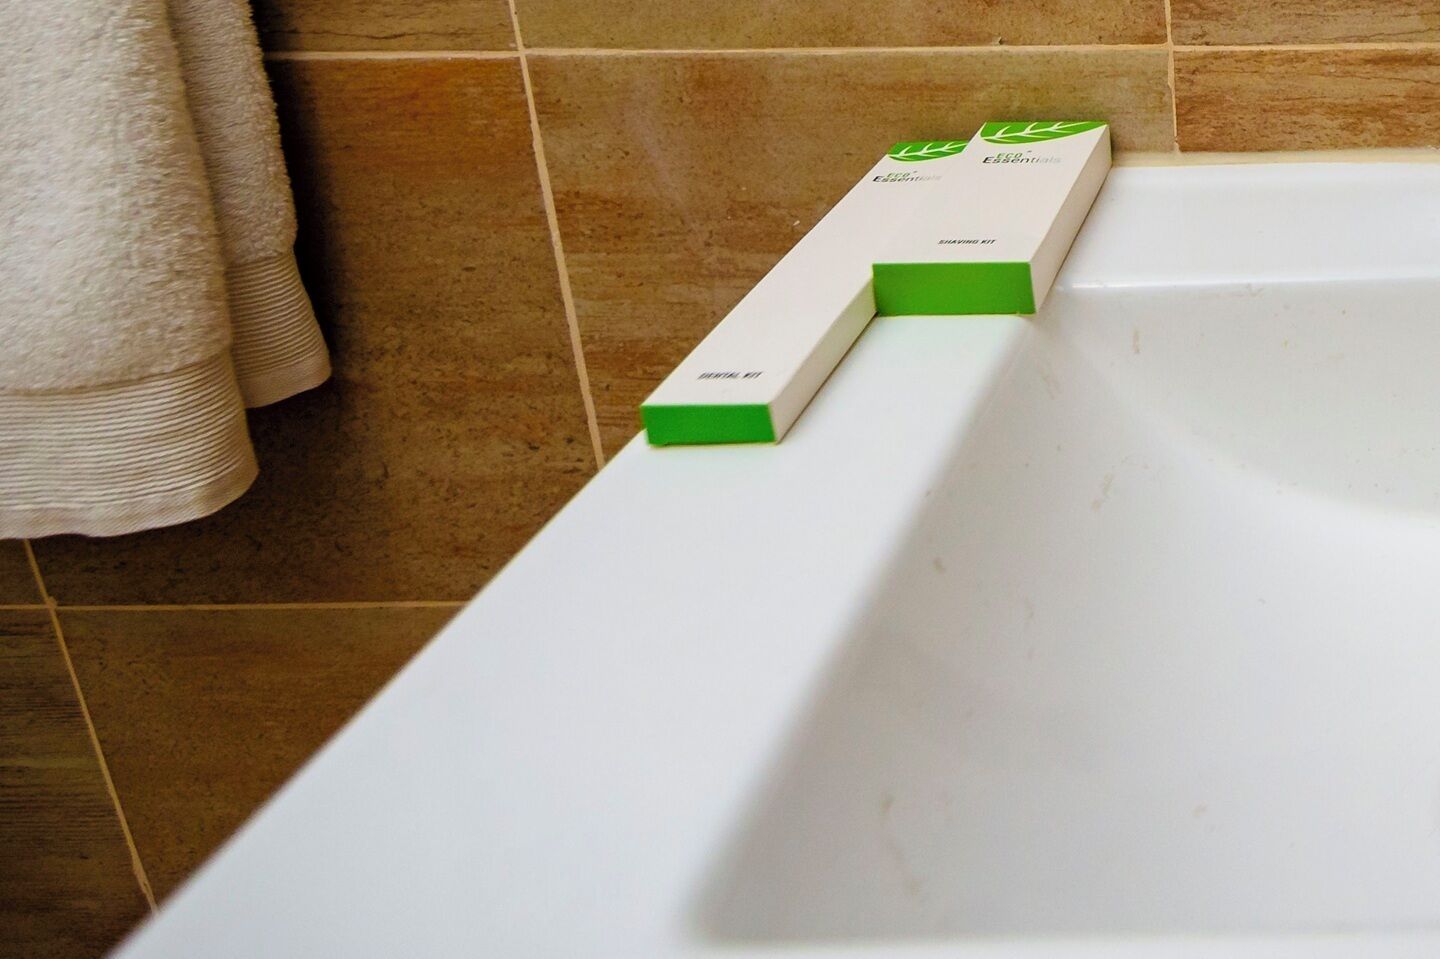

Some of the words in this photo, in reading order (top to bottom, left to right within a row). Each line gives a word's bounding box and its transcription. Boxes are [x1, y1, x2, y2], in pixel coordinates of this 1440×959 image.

[982, 156, 1061, 164] Essentials
[872, 175, 943, 183] Essentials
[697, 371, 741, 380] DENTAL
[742, 371, 763, 379] KIT
